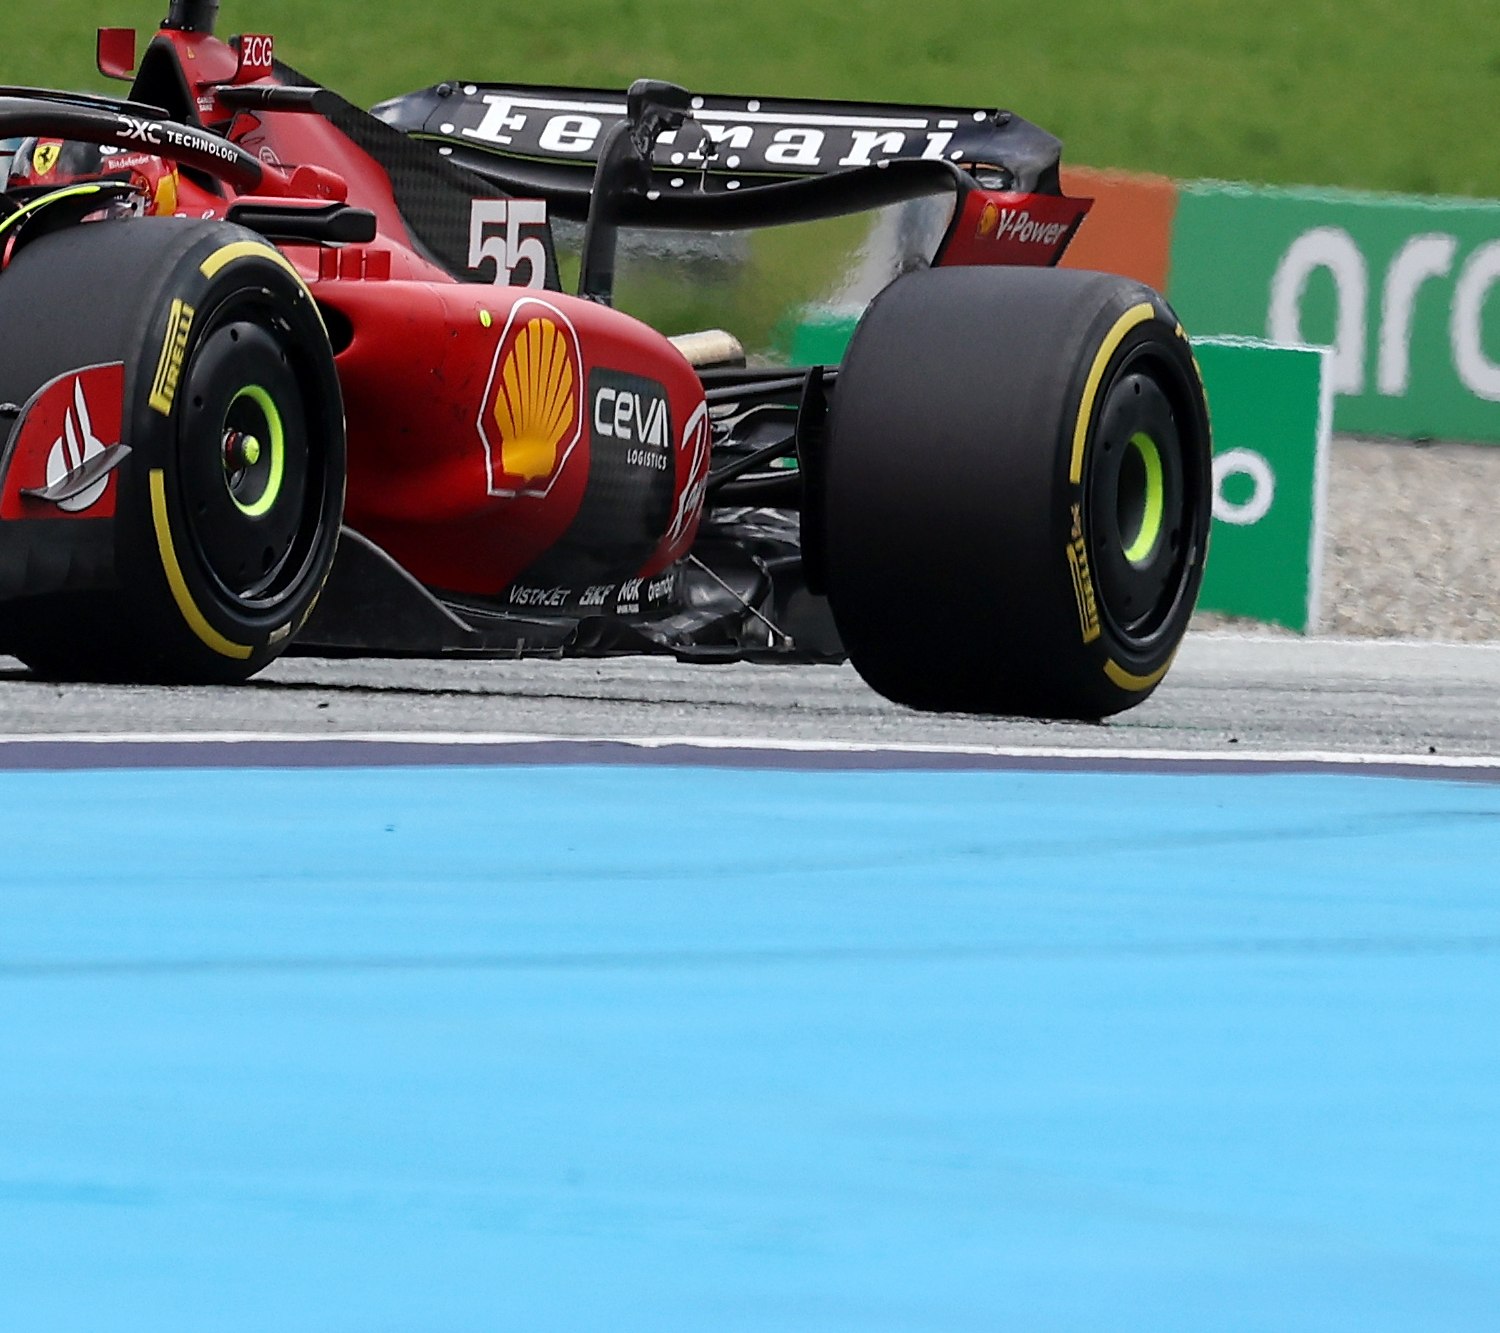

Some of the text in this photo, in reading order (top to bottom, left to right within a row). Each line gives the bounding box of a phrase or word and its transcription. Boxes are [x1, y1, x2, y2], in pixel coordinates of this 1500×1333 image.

[116, 116, 239, 165] DXC TECHNOLOGY
[462, 94, 965, 169] Ferari
[469, 198, 548, 287] 55
[994, 209, 1070, 247] V-Power
[149, 298, 195, 417] PIRELLI
[626, 448, 668, 470] LOGISTICS
